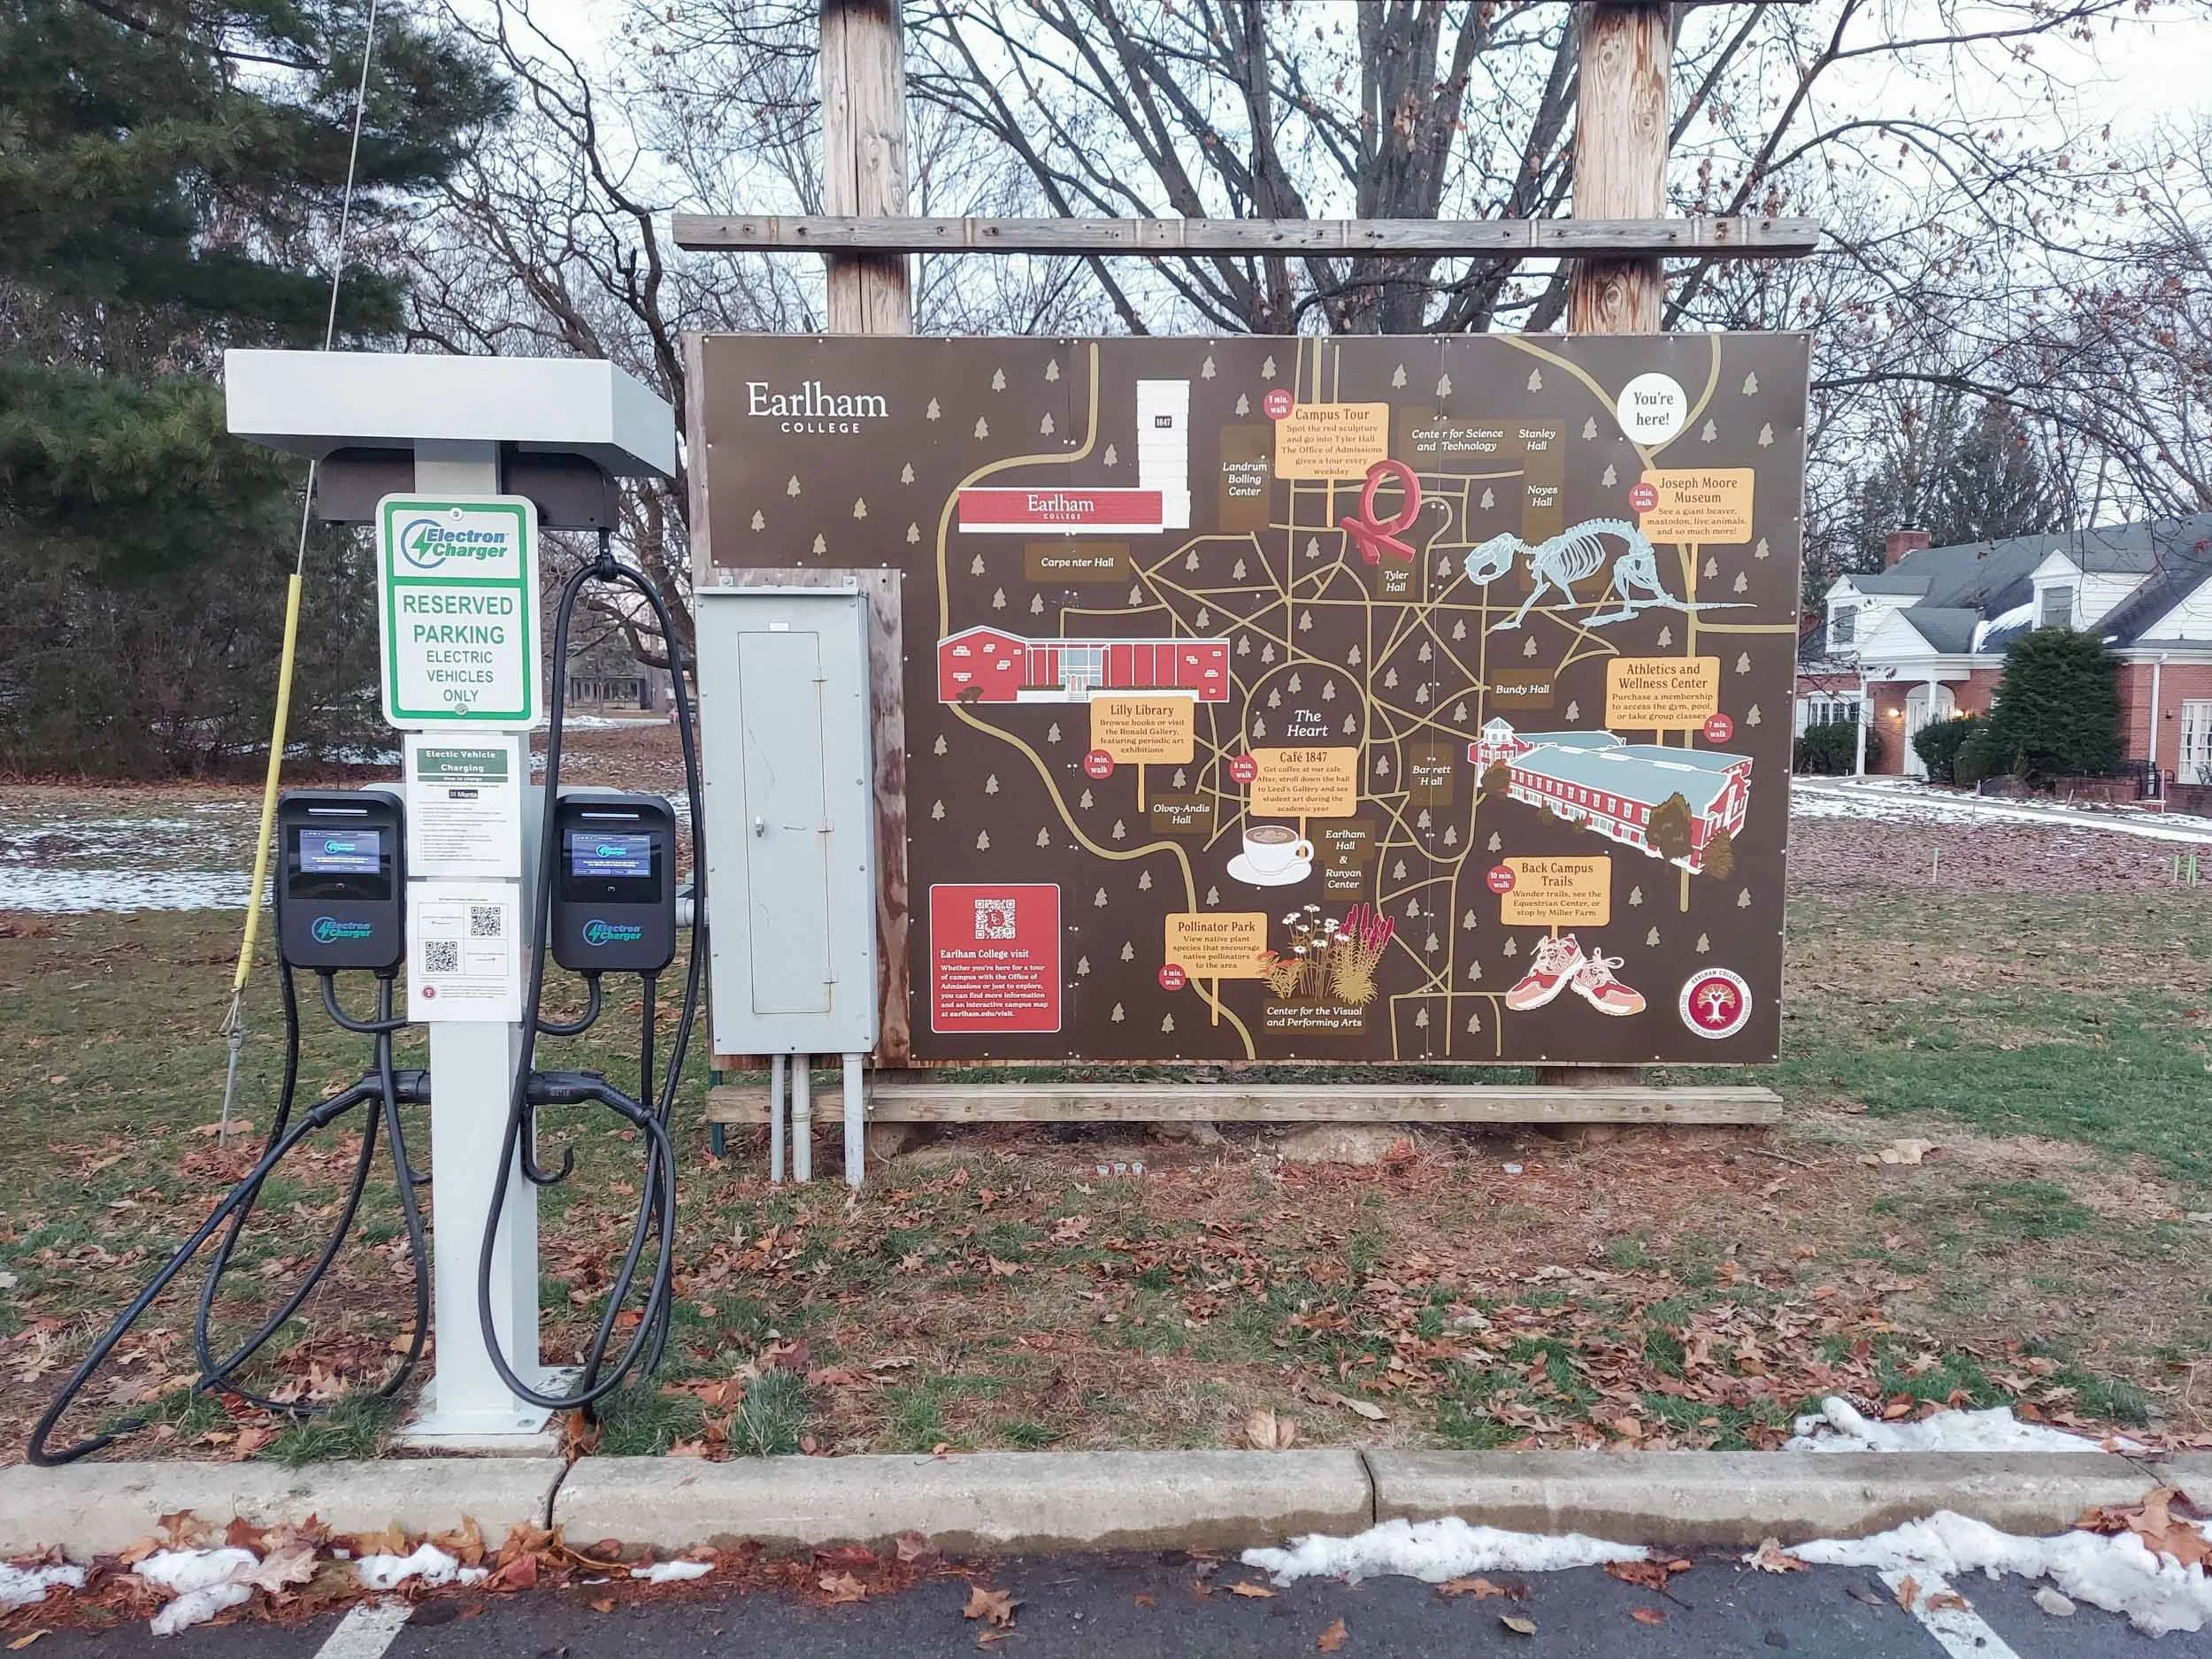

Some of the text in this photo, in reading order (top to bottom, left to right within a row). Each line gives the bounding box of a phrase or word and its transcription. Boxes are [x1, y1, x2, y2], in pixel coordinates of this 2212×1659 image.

[746, 381, 889, 417] Earlham
[1634, 392, 1674, 405] You're
[1296, 409, 1371, 422] Campus Tour
[1636, 413, 1670, 426] here!
[781, 422, 860, 433] COLLEGE
[1156, 418, 1171, 426] 1847
[1412, 429, 1503, 441] Center for Science
[1518, 429, 1555, 441] Stanley
[1417, 442, 1497, 452] and Technology
[1223, 463, 1267, 472] Landrum
[1228, 474, 1262, 486] Bolling
[1659, 478, 1738, 490] Joseph Moore
[1229, 487, 1261, 496] Center
[1527, 486, 1558, 495] Noyes
[1027, 495, 1094, 511] Earlham
[1532, 498, 1553, 507] Hall
[1674, 492, 1721, 503] Museum
[426, 528, 504, 542] Electron
[432, 543, 508, 560] Charger
[1041, 557, 1092, 568] Carpenter
[1384, 571, 1409, 581] Tyler
[1386, 583, 1406, 592] Hall
[403, 595, 513, 615] RESERVED
[414, 625, 504, 644] PARKING
[426, 650, 493, 664] ELECTRIC
[1627, 664, 1700, 675] Athletics and
[427, 670, 494, 683] VEHICLES
[1618, 678, 1708, 688] Wellness Center
[443, 689, 479, 702] ONLY
[1496, 686, 1527, 695] Bundy
[1110, 704, 1174, 717] Lilly Library
[1294, 710, 1321, 722] The
[1286, 724, 1328, 737] Heart
[1280, 752, 1327, 763] Café 1847
[1412, 765, 1451, 774] Barrett
[1420, 777, 1443, 786] Hall
[1154, 804, 1210, 814] Olvey-Andis
[1325, 830, 1365, 839] Earlham
[1336, 841, 1355, 850] Hall
[1325, 869, 1362, 879] Runyan
[1522, 863, 1594, 875] Back Campus
[1542, 877, 1573, 886] Trails
[1178, 922, 1256, 932] Pollinator Park
[941, 949, 1029, 959] Earlham College visit
[1300, 1007, 1314, 1017] for
[1333, 1007, 1363, 1016] Visual
[1287, 1018, 1339, 1027] Performing
